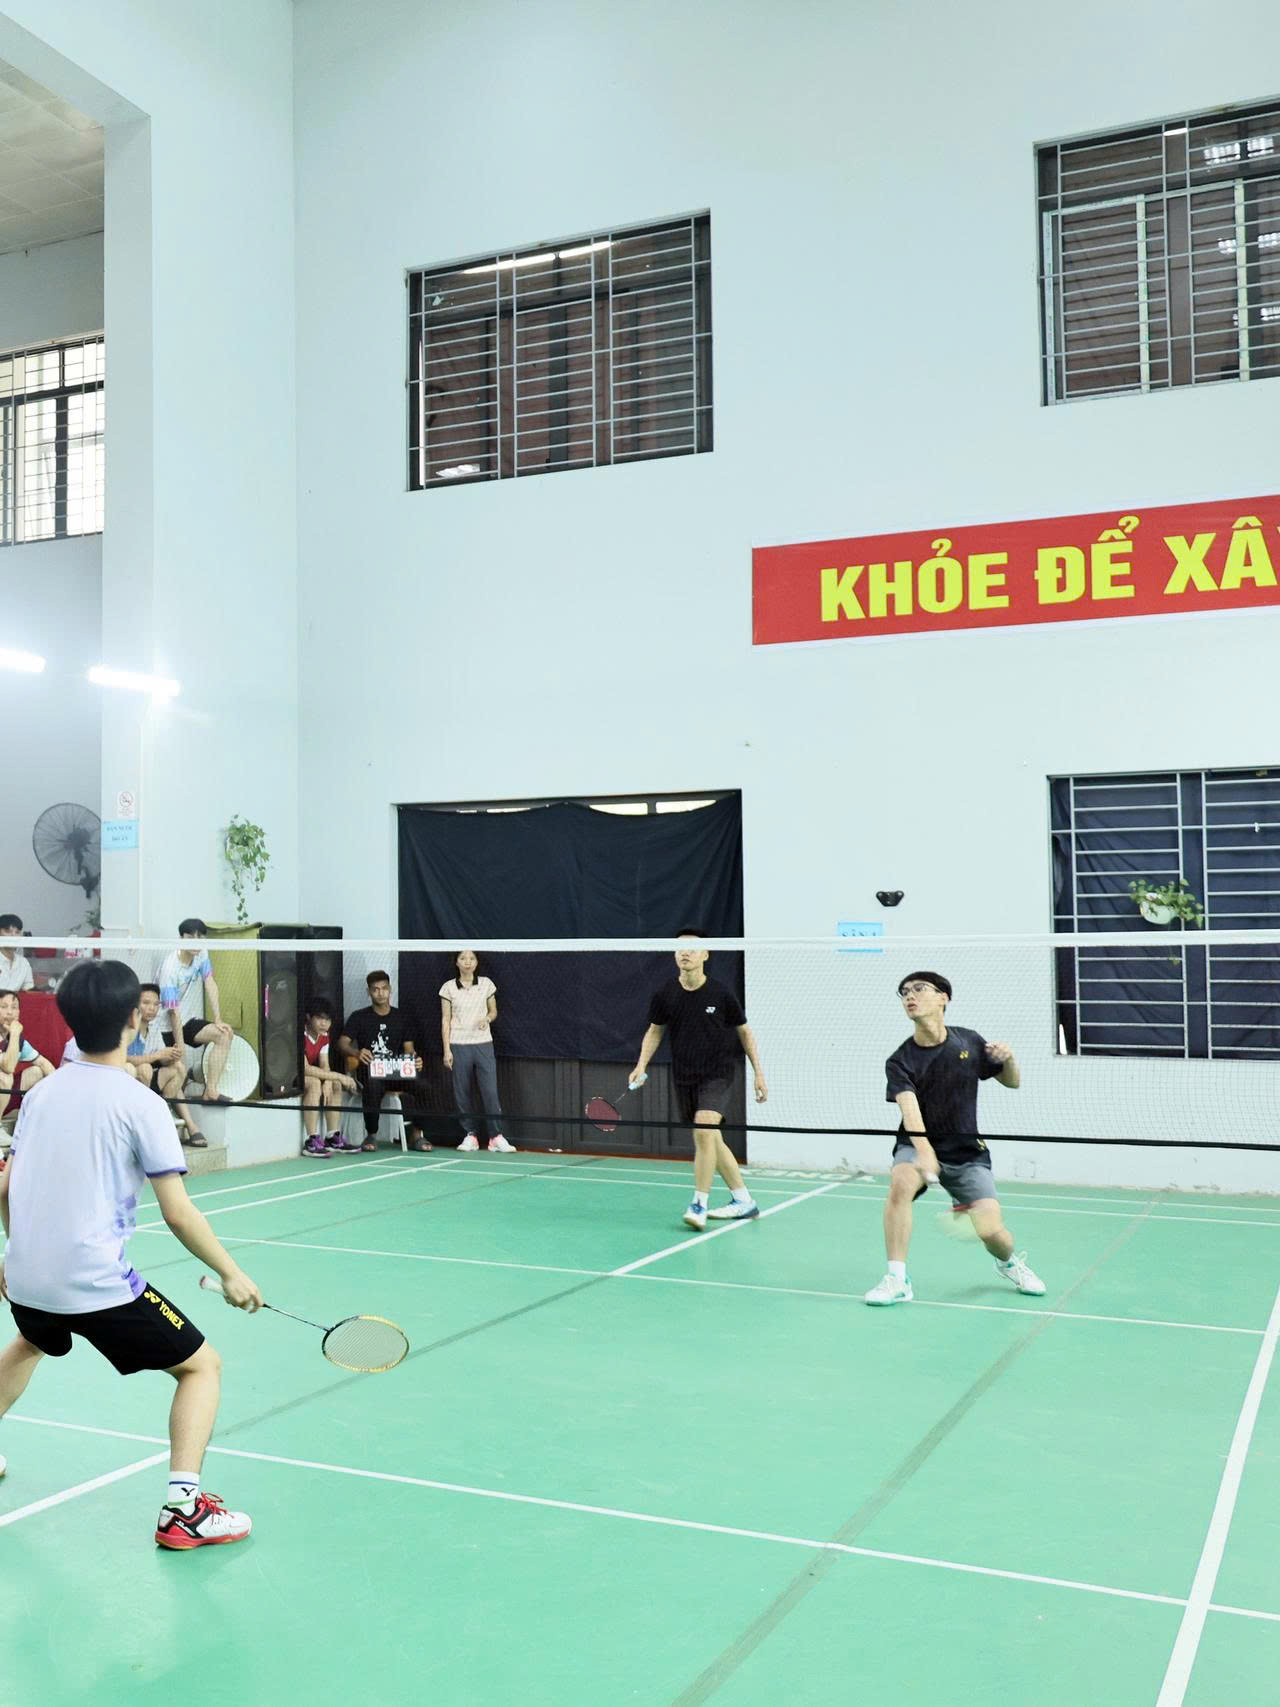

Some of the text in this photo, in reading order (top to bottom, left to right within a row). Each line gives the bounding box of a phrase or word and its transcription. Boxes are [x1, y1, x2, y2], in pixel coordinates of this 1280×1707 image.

[820, 515, 1280, 622] KHỎE ĐỂ XÂ
[371, 1062, 385, 1075] 15
[403, 1062, 414, 1076] 6
[159, 1301, 185, 1330] YONEX
